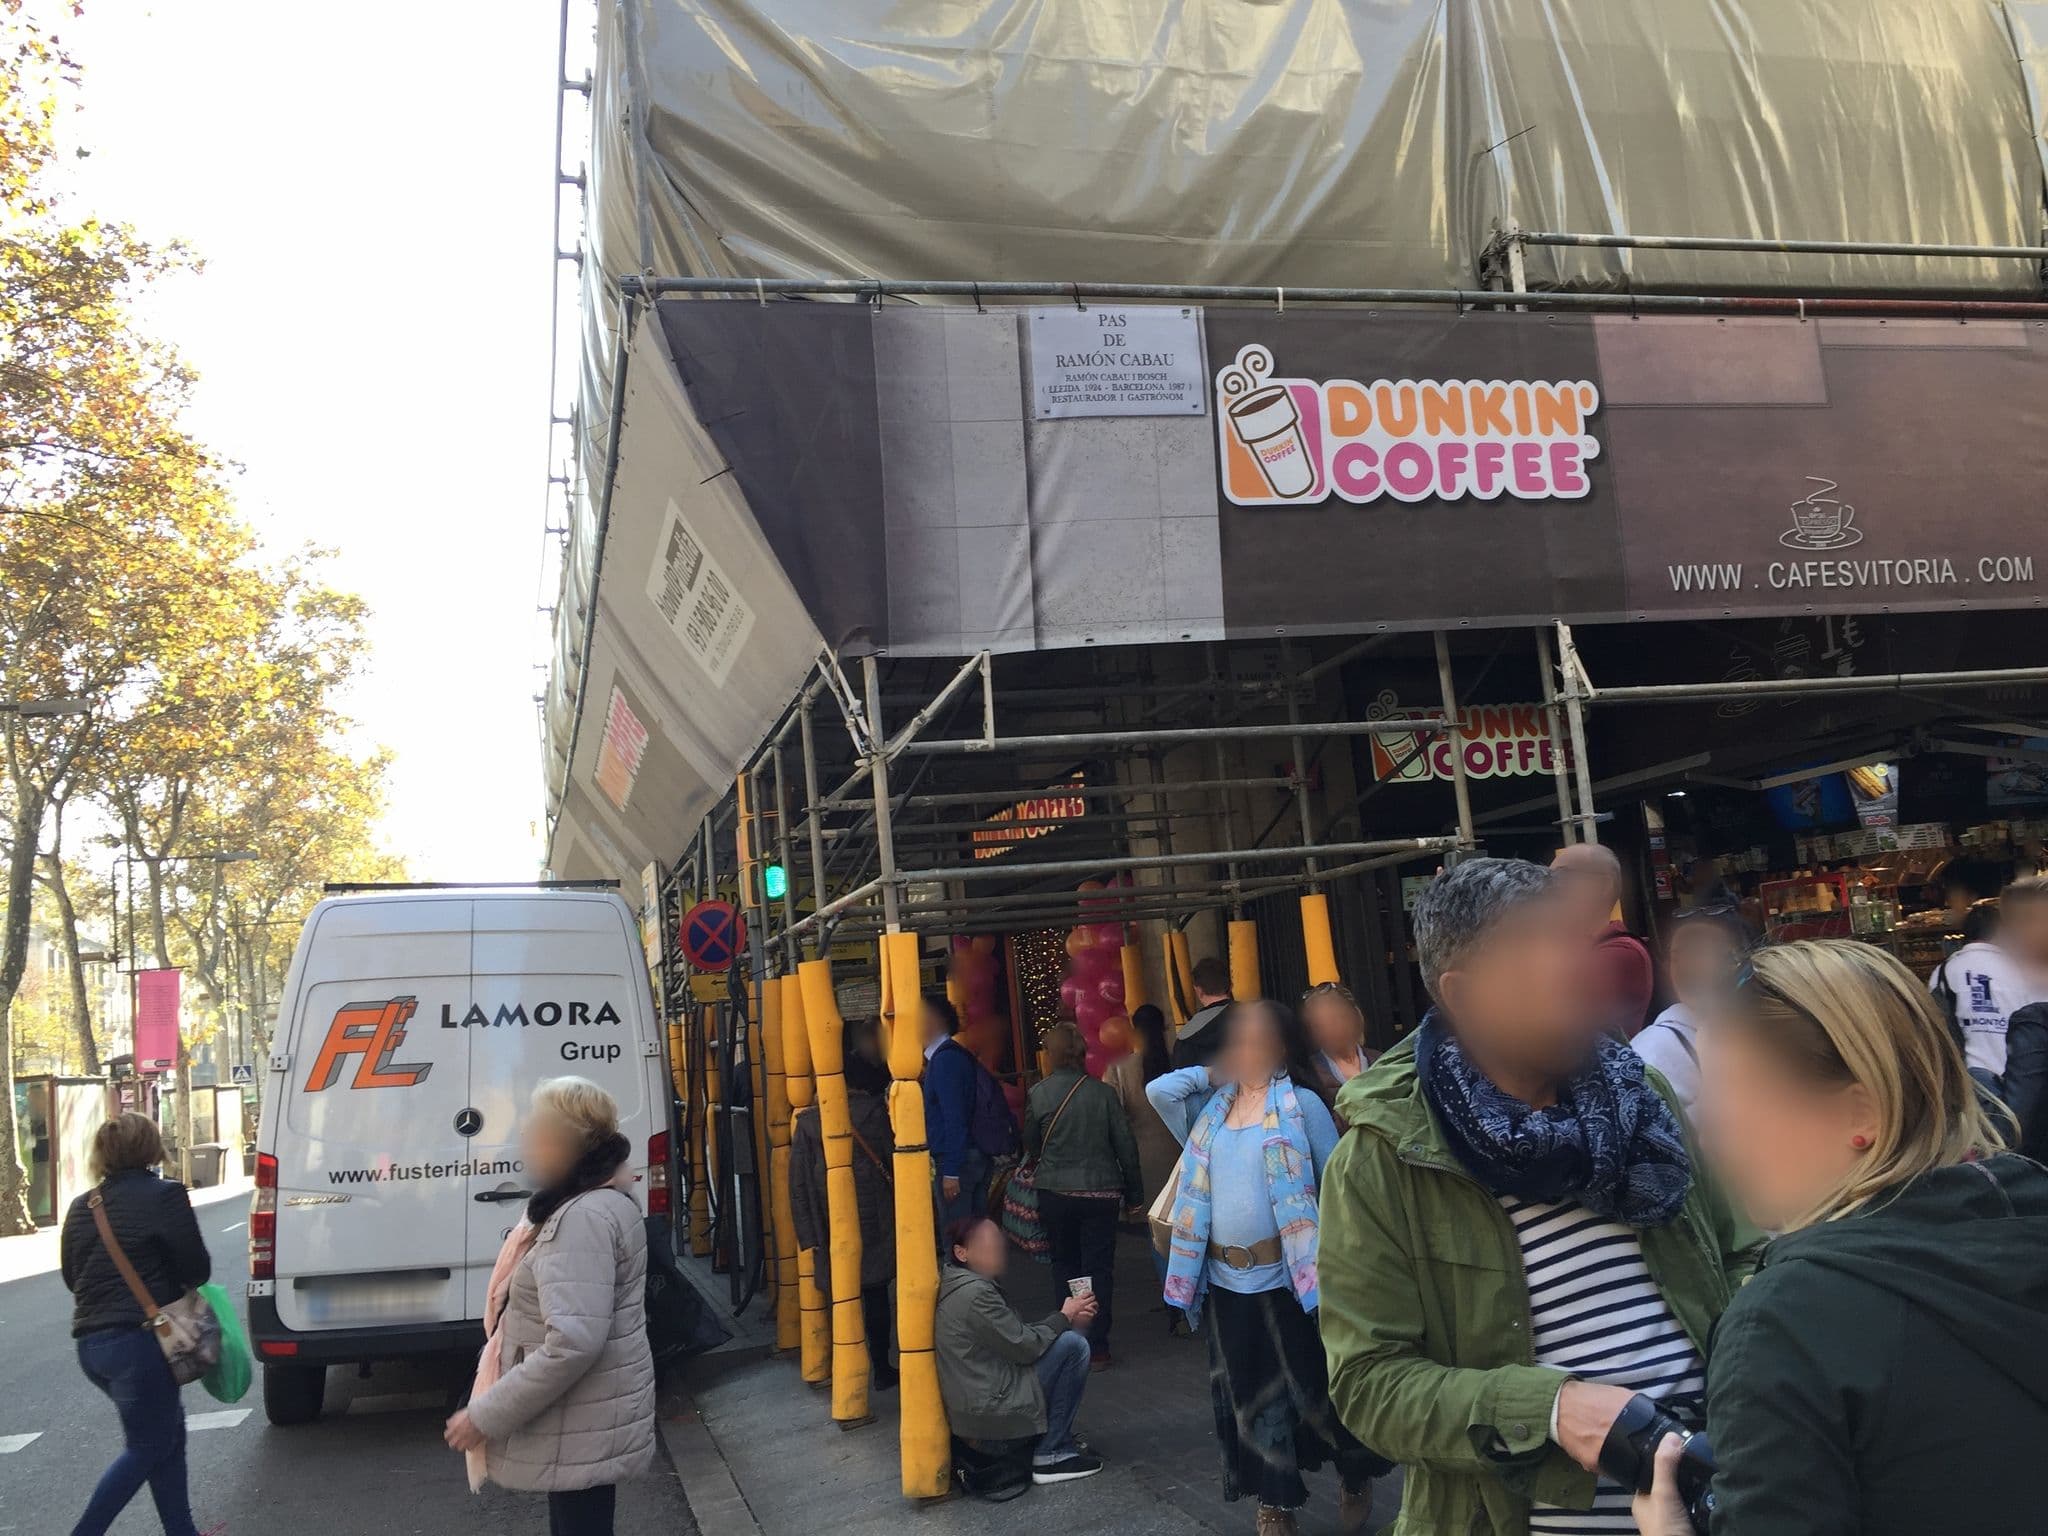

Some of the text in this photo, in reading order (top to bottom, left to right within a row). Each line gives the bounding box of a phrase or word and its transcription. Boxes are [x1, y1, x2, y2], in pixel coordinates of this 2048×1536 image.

[1099, 314, 1127, 327] PAS
[1103, 334, 1126, 347] DE
[1056, 351, 1174, 368] RAMÓN CABAU
[1065, 372, 1099, 383] RAMÓN
[1137, 373, 1167, 381] BOSCH
[1112, 382, 1164, 392] BARCELONA
[1168, 382, 1185, 391] 1987
[1052, 393, 1116, 404] RESTAURADOR
[1127, 391, 1184, 401] GASTRÓNOM
[1327, 386, 1593, 438] DUNKIN'
[1263, 444, 1297, 464] COFFEE
[1332, 441, 1584, 496] COFFEE
[1768, 558, 1957, 589] CAFESVITORIA
[1977, 556, 2034, 583] COM
[441, 1001, 622, 1029] LAMORA
[560, 1041, 621, 1063] Grup
[329, 1159, 524, 1185] www.fusterialamo
